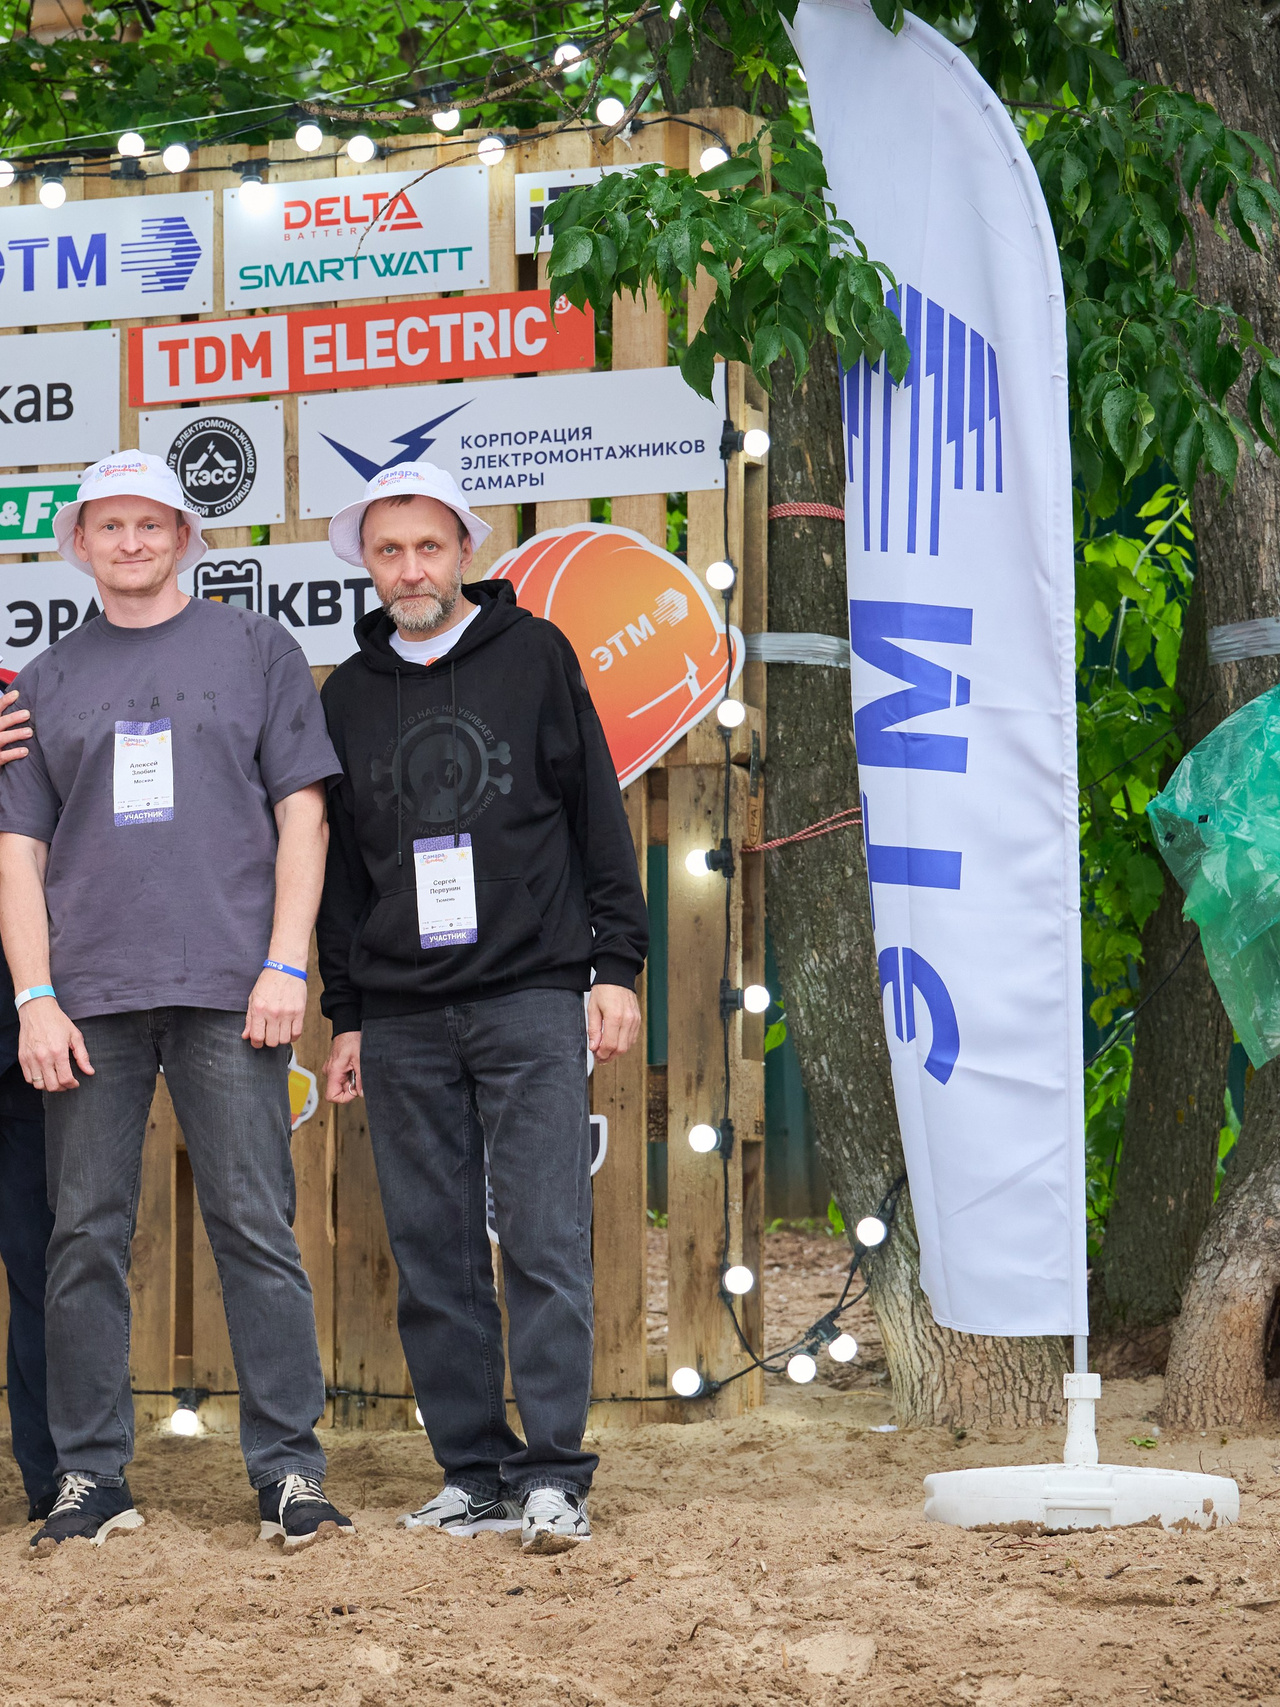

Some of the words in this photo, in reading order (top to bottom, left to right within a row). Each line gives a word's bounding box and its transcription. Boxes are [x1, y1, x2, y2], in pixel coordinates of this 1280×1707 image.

[284, 192, 423, 232] DELTA
[239, 247, 472, 290] SMARTWATT
[158, 330, 271, 387] TDM
[175, 419, 255, 474] ЭЛЕКТРОМОНТАЖНИКОВ
[461, 427, 593, 449] КОРПОРАЦИЯ
[167, 453, 179, 474] ЛУБ
[461, 439, 705, 470] ЭЛЕКТРОМОНТАЖНИКОВ
[98, 462, 142, 473] Самара
[186, 468, 237, 487] КЭСС
[377, 470, 420, 483] Самара
[461, 472, 544, 491] САМАРЫ
[214, 479, 252, 515] СТОЛИЦЫ
[590, 613, 657, 672] ЭТМ
[457, 706, 496, 746] УБИВАЕТ,
[129, 760, 159, 769] Алексей
[124, 811, 164, 821] УЧАСТНИК
[439, 788, 497, 836] ОСОРОЖНЕЕ
[433, 877, 457, 887] Сергей
[429, 931, 467, 943] УЧАСТНИК
